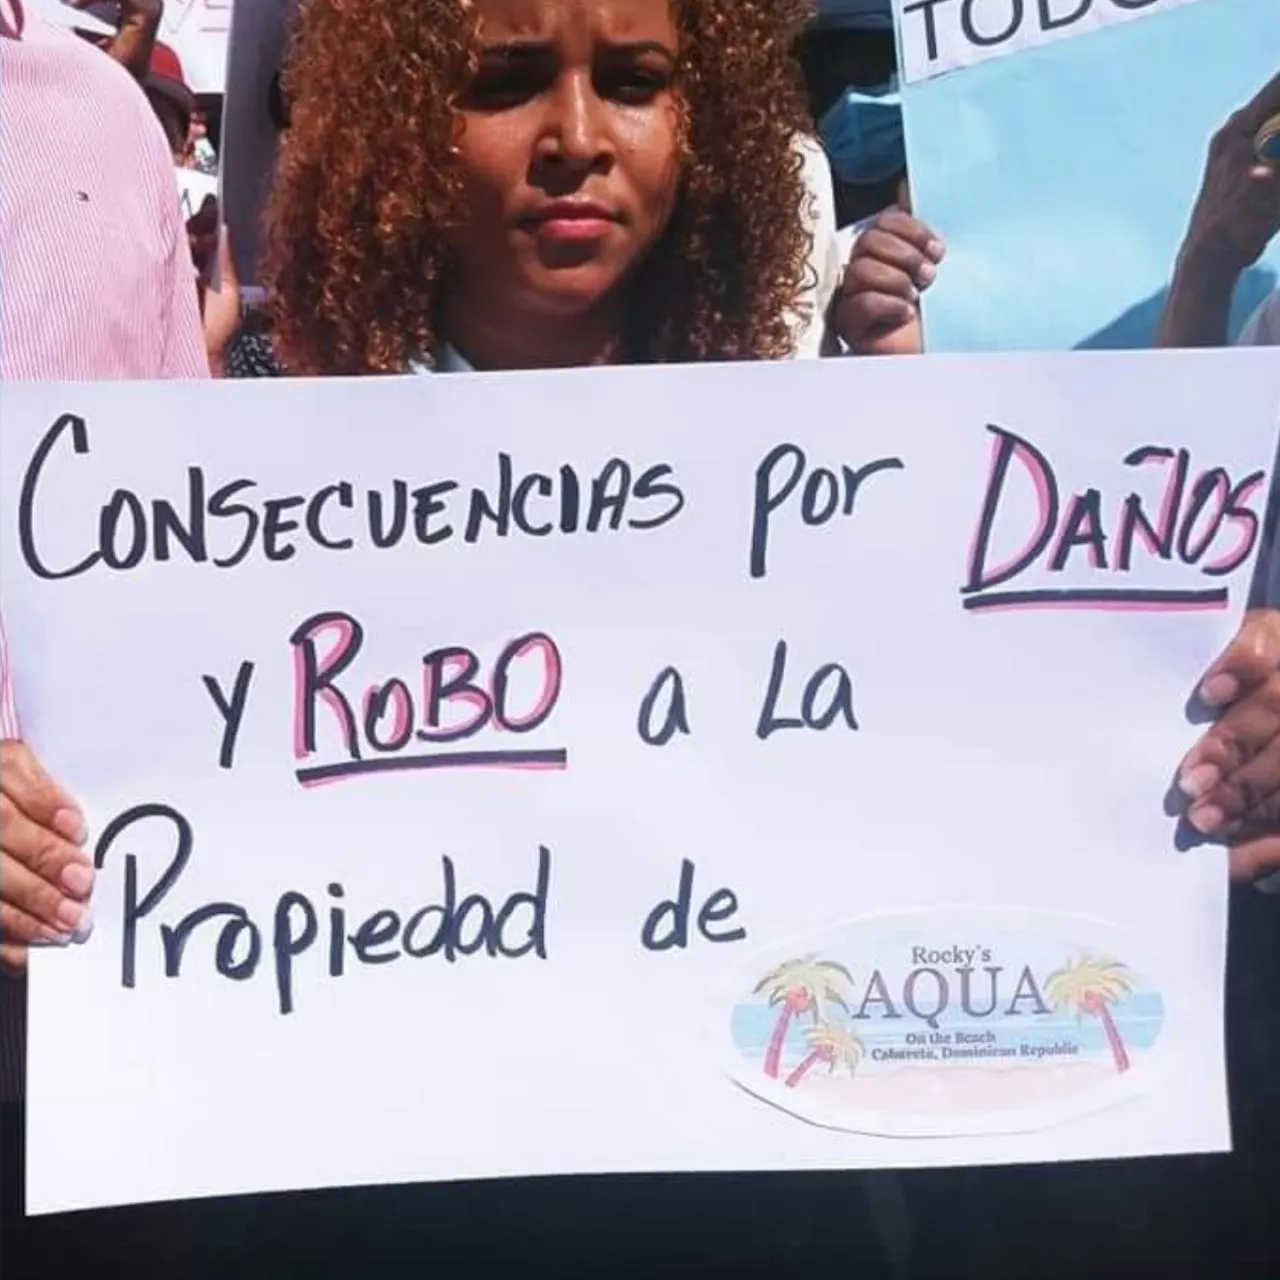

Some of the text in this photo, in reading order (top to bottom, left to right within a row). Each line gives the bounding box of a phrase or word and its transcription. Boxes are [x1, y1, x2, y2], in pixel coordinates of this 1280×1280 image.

[19, 413, 686, 581] CONSECUENCIAS
[963, 422, 1261, 595] DAÑOS
[637, 665, 692, 746] a
[94, 803, 750, 1014] Propiedad de
[911, 944, 993, 967] Rocky's
[851, 964, 1054, 1029] AQUA
[904, 1030, 997, 1046] On the Beach
[941, 1045, 1018, 1060] Dominican
[1019, 1042, 1080, 1058] Republic
